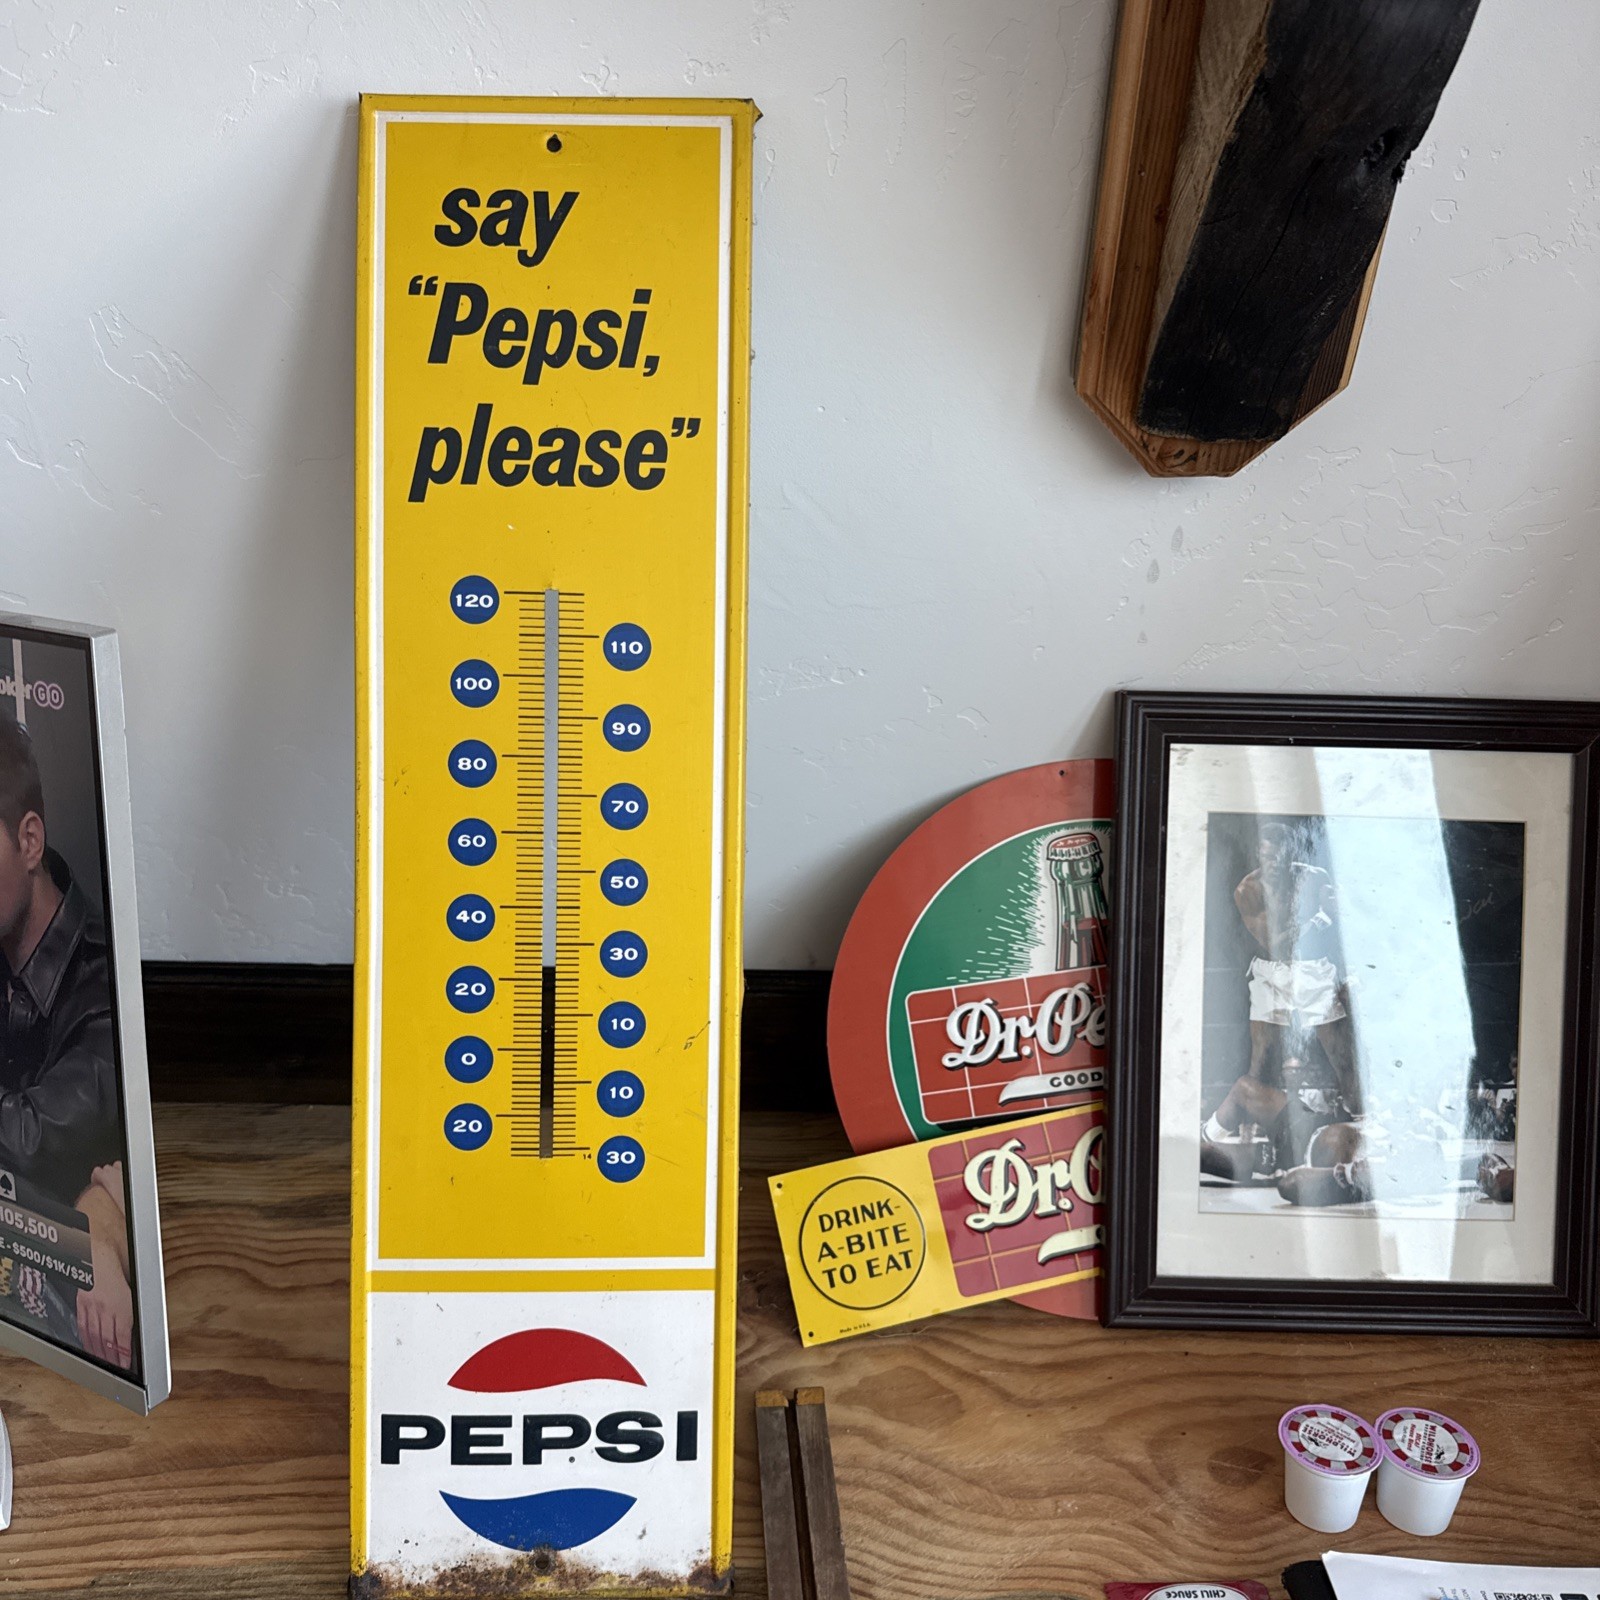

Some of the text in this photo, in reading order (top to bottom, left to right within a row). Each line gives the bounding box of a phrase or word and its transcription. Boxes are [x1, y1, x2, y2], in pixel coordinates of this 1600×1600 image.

[433, 187, 580, 268] say
[408, 275, 661, 386] “Pepsi,
[407, 403, 702, 503] please”
[455, 593, 494, 608] 120
[611, 640, 644, 655] 110
[455, 677, 493, 691] 100
[611, 721, 642, 736] 90
[457, 757, 488, 771] 80
[611, 800, 640, 814] 70
[457, 834, 487, 848] 60
[610, 875, 639, 889] 50
[455, 910, 487, 924] 40
[609, 947, 639, 961] 30
[454, 982, 487, 996] 20
[611, 1017, 635, 1031] 10
[461, 1052, 477, 1066] 0
[1049, 1071, 1103, 1088] GOOD
[609, 1085, 634, 1100] 10
[452, 1119, 483, 1133] 20
[606, 1150, 636, 1164] 30
[817, 1198, 901, 1234] DRINK-
[817, 1222, 911, 1263] A-BITE
[822, 1249, 914, 1290] TO EAT
[380, 1410, 699, 1466] PEPSI
[1302, 1426, 1355, 1457] WILDHORSE
[1424, 1424, 1438, 1464] WILDHORSE
[1165, 1590, 1226, 1599] CHILI SAUCE
